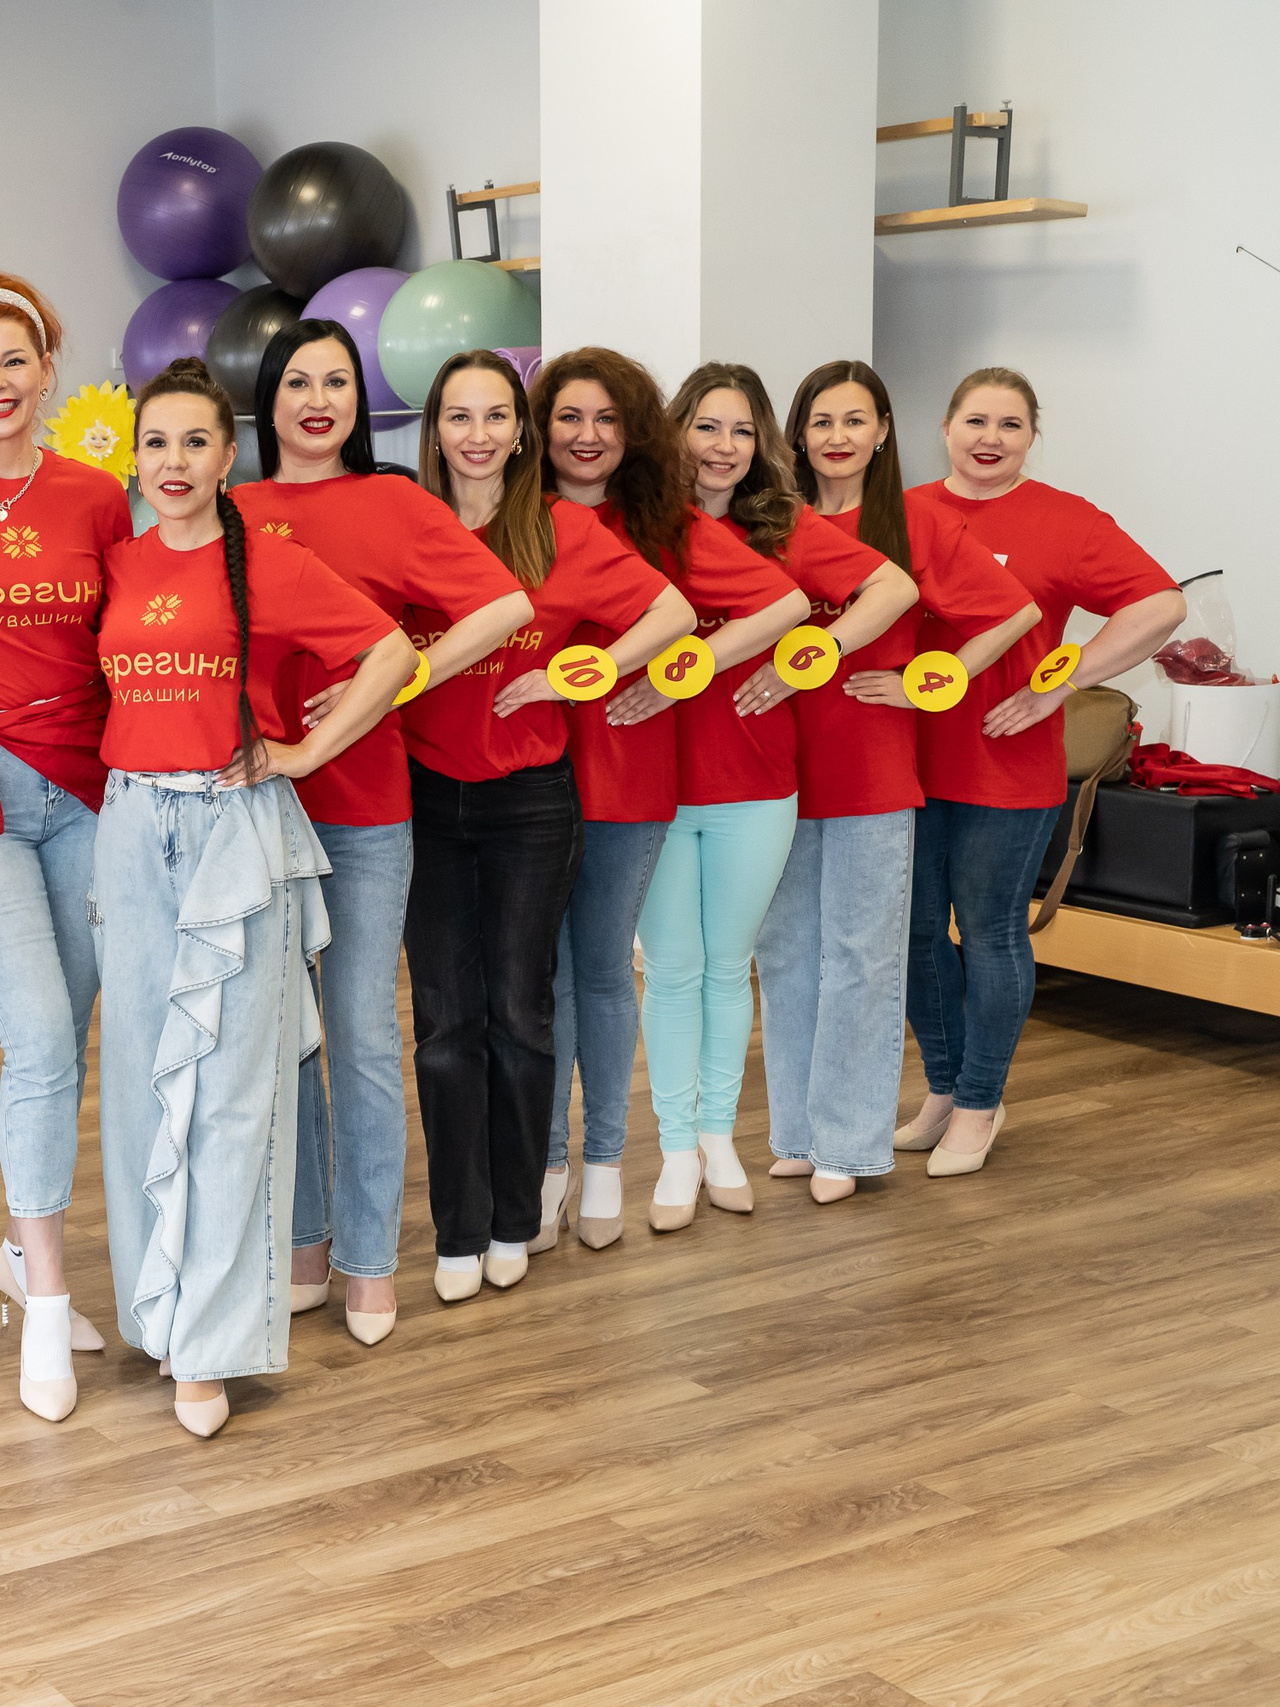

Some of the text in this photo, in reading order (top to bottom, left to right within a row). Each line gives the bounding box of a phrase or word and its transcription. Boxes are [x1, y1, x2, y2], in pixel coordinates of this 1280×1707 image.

[100, 651, 238, 683] ерегиня
[558, 655, 605, 688] 10
[664, 651, 698, 682] 8
[917, 672, 954, 694] 4
